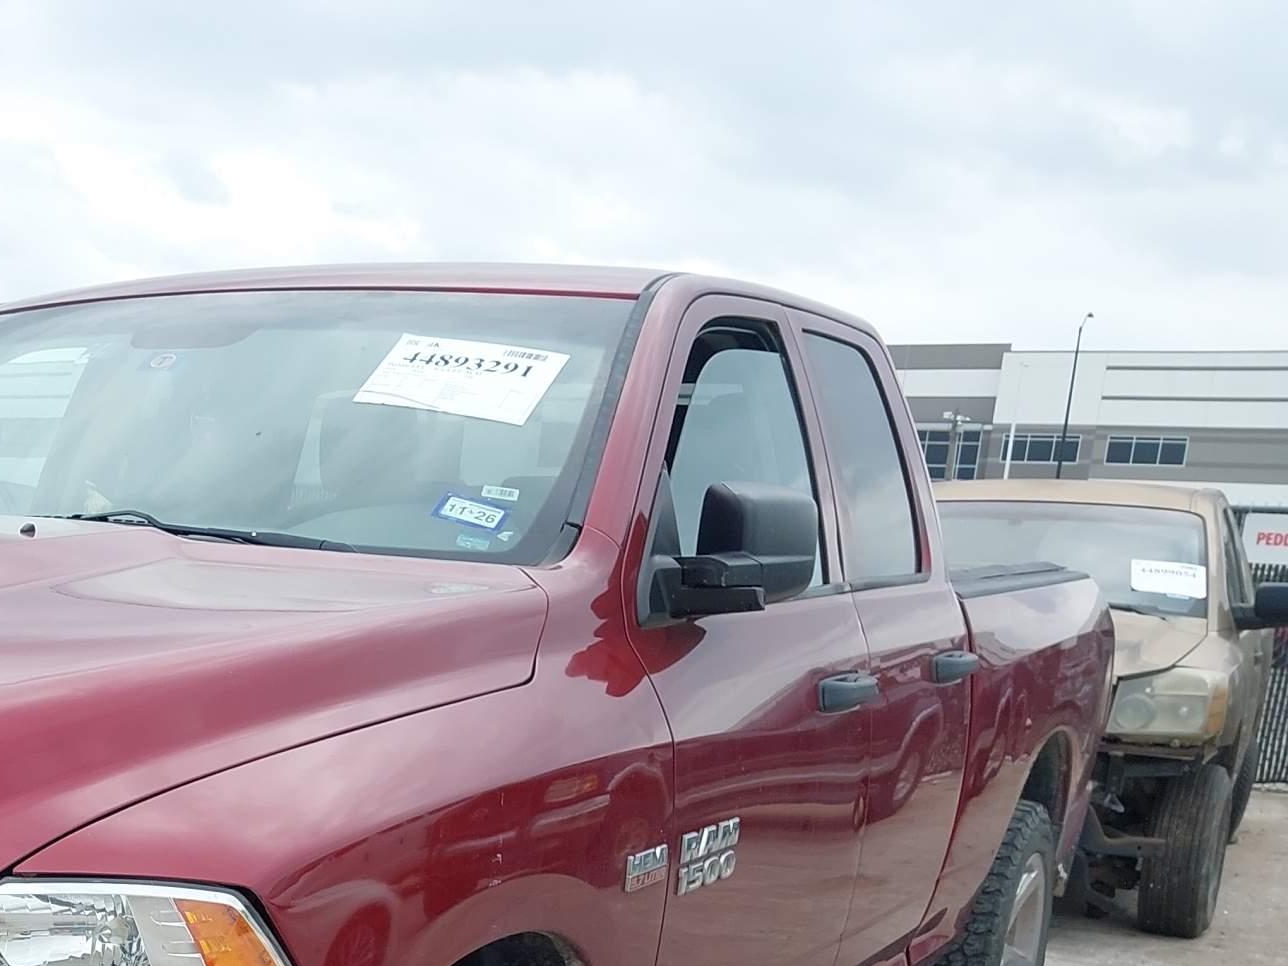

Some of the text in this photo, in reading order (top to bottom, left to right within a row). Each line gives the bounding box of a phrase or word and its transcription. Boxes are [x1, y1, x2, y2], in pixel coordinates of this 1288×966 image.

[402, 351, 534, 378] 44893291
[447, 503, 497, 524] 11-26
[680, 816, 740, 865] RAM
[677, 850, 736, 896] 1500
